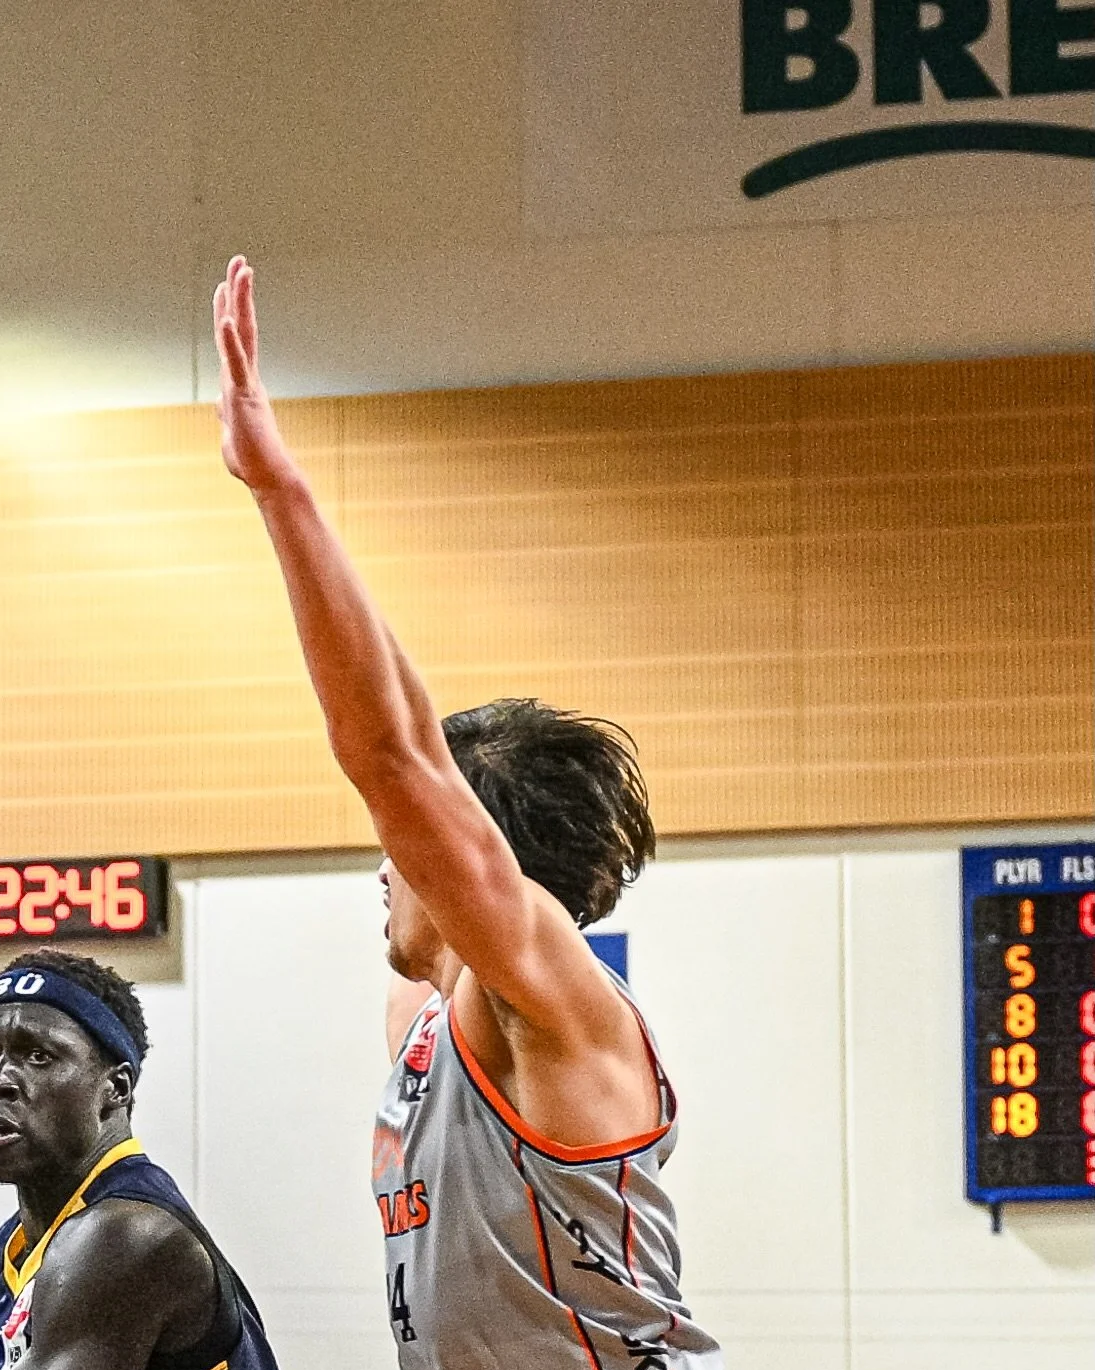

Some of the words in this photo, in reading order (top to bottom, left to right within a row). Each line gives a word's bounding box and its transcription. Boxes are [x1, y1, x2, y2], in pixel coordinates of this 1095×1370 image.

[994, 857, 1042, 885] PLYR
[1019, 898, 1034, 935] 1
[1005, 943, 1036, 989] 5
[1005, 992, 1037, 1038] 8
[990, 1042, 1038, 1088] 10
[990, 1091, 1039, 1138] 18
